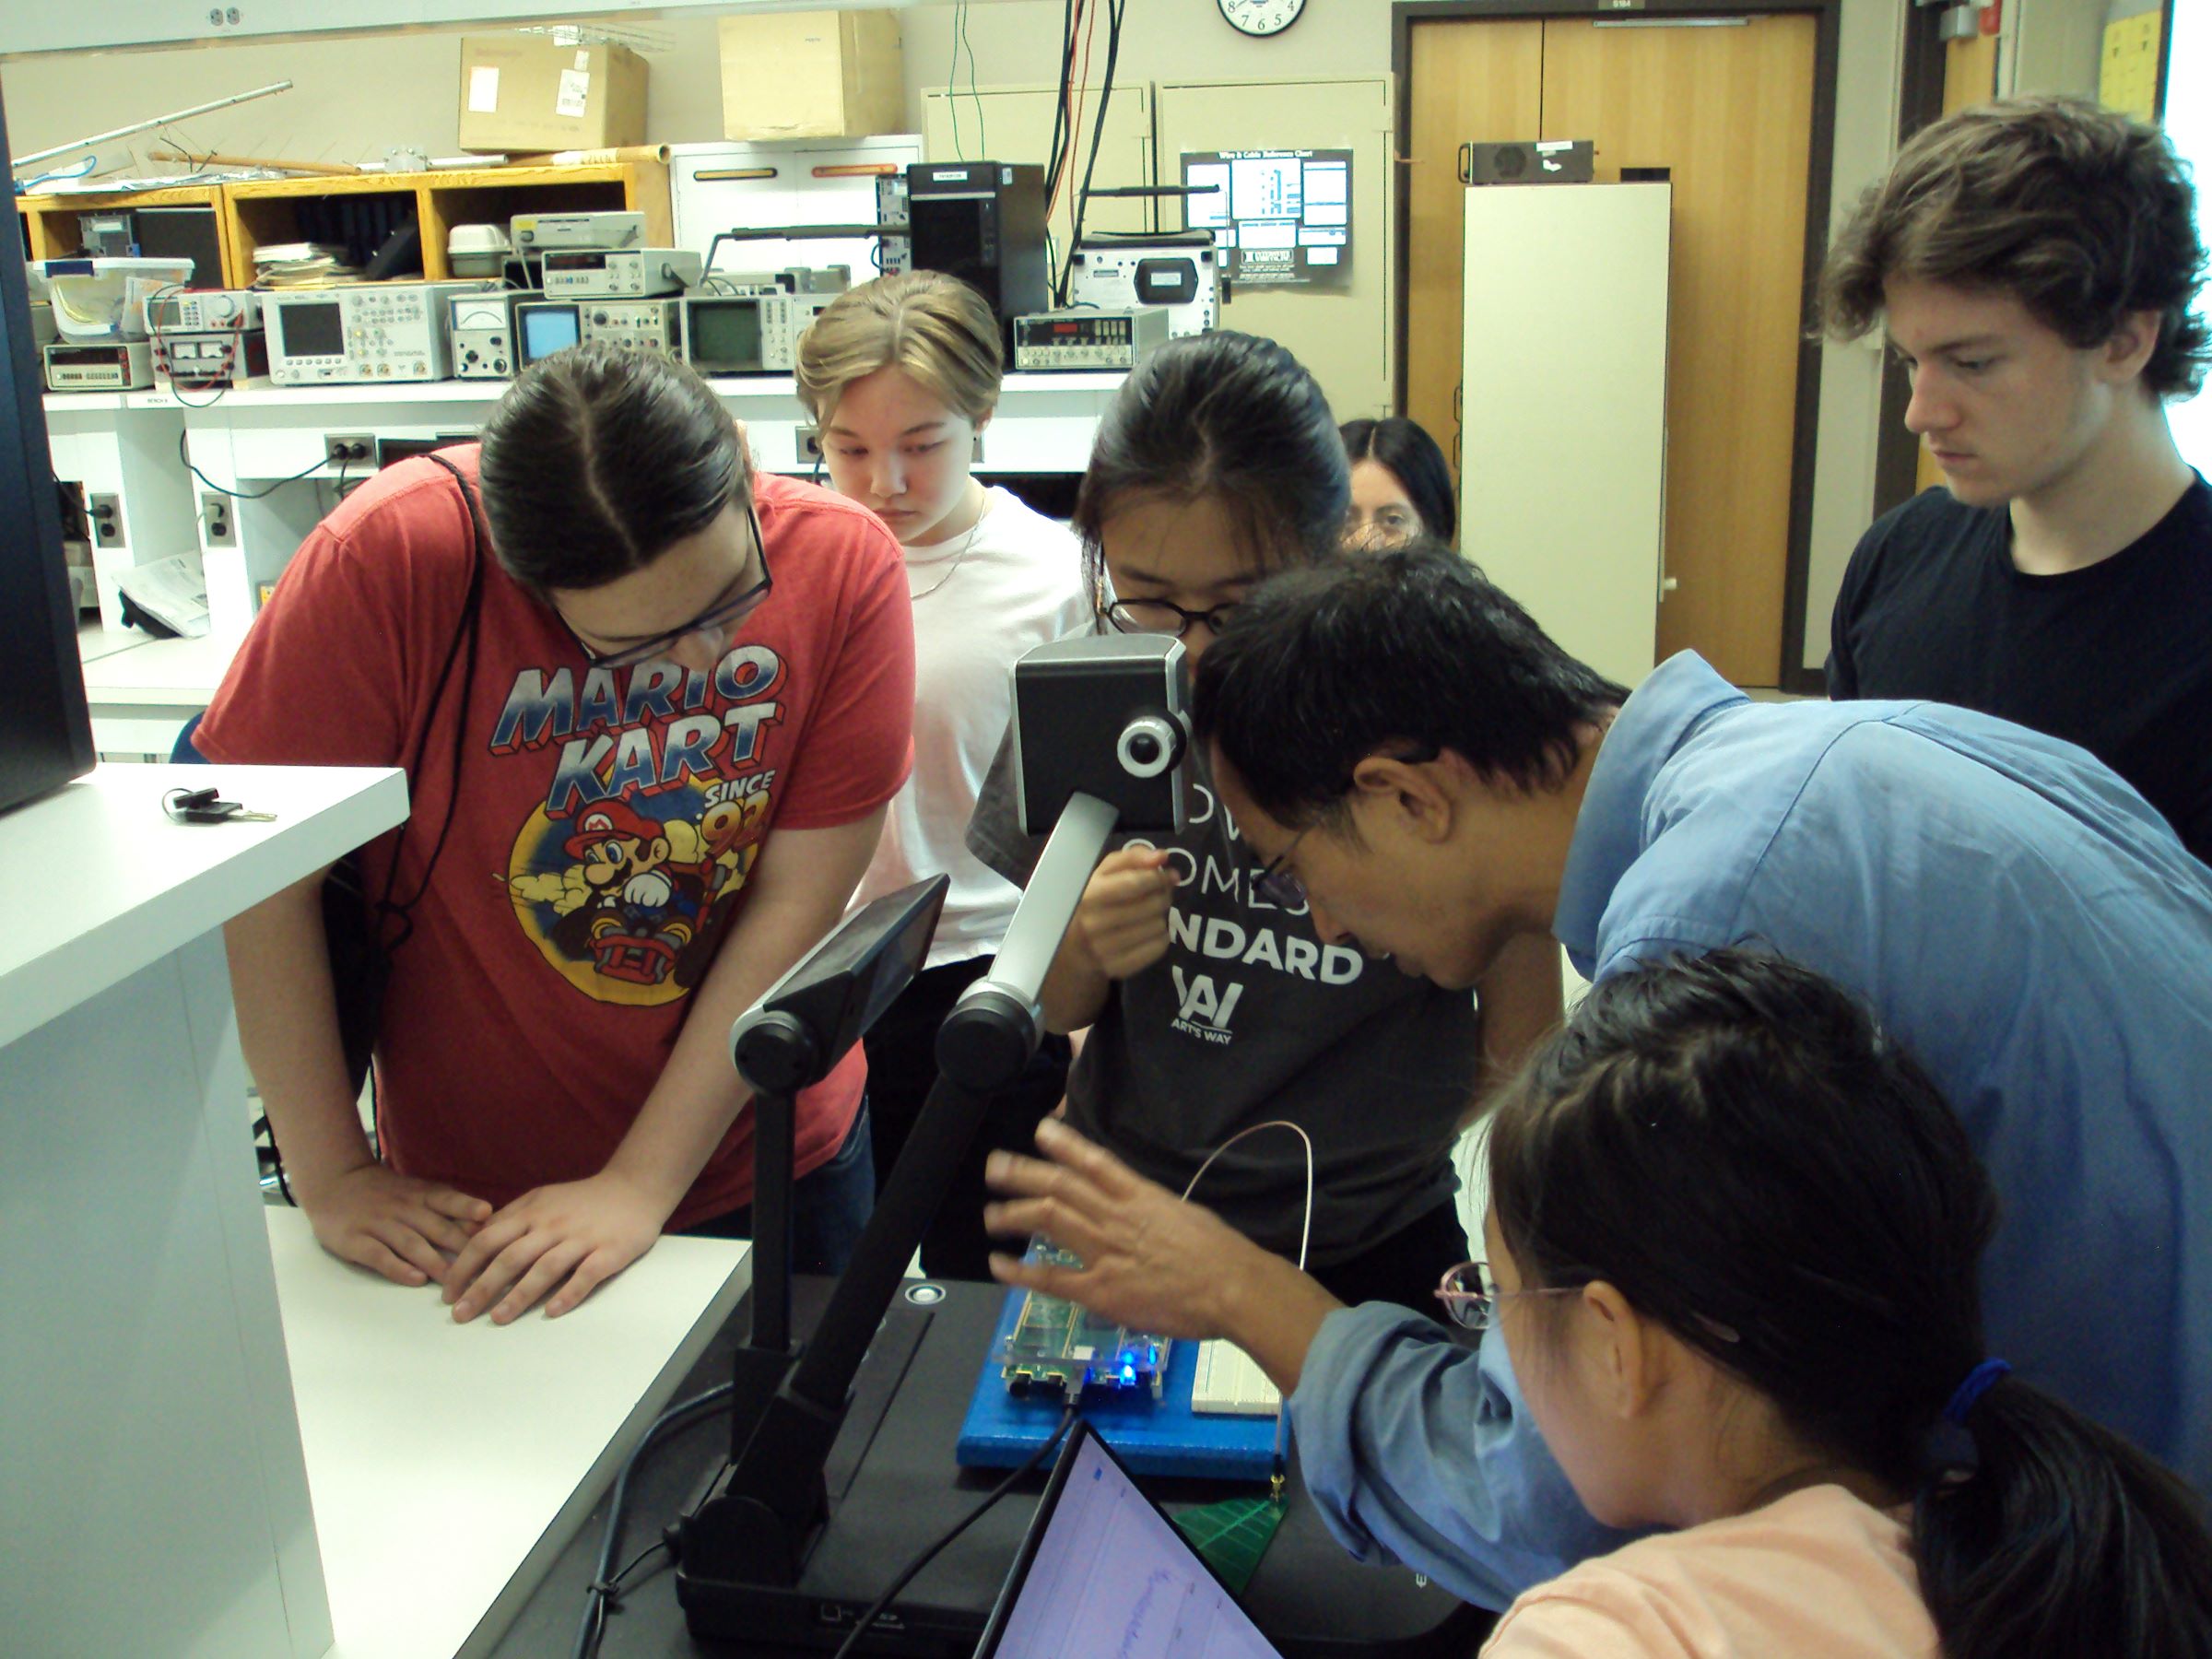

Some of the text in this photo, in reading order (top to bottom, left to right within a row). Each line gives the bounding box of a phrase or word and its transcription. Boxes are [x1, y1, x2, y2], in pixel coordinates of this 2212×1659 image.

[1228, 1, 1236, 13] 8
[1241, 15, 1249, 27] 7
[1257, 18, 1265, 30] 6
[1274, 14, 1281, 26] 5
[489, 644, 789, 756] MARIO
[546, 701, 785, 820] KART
[704, 770, 776, 808] SINCE
[1171, 1018, 1232, 1045] ART'S WAY
